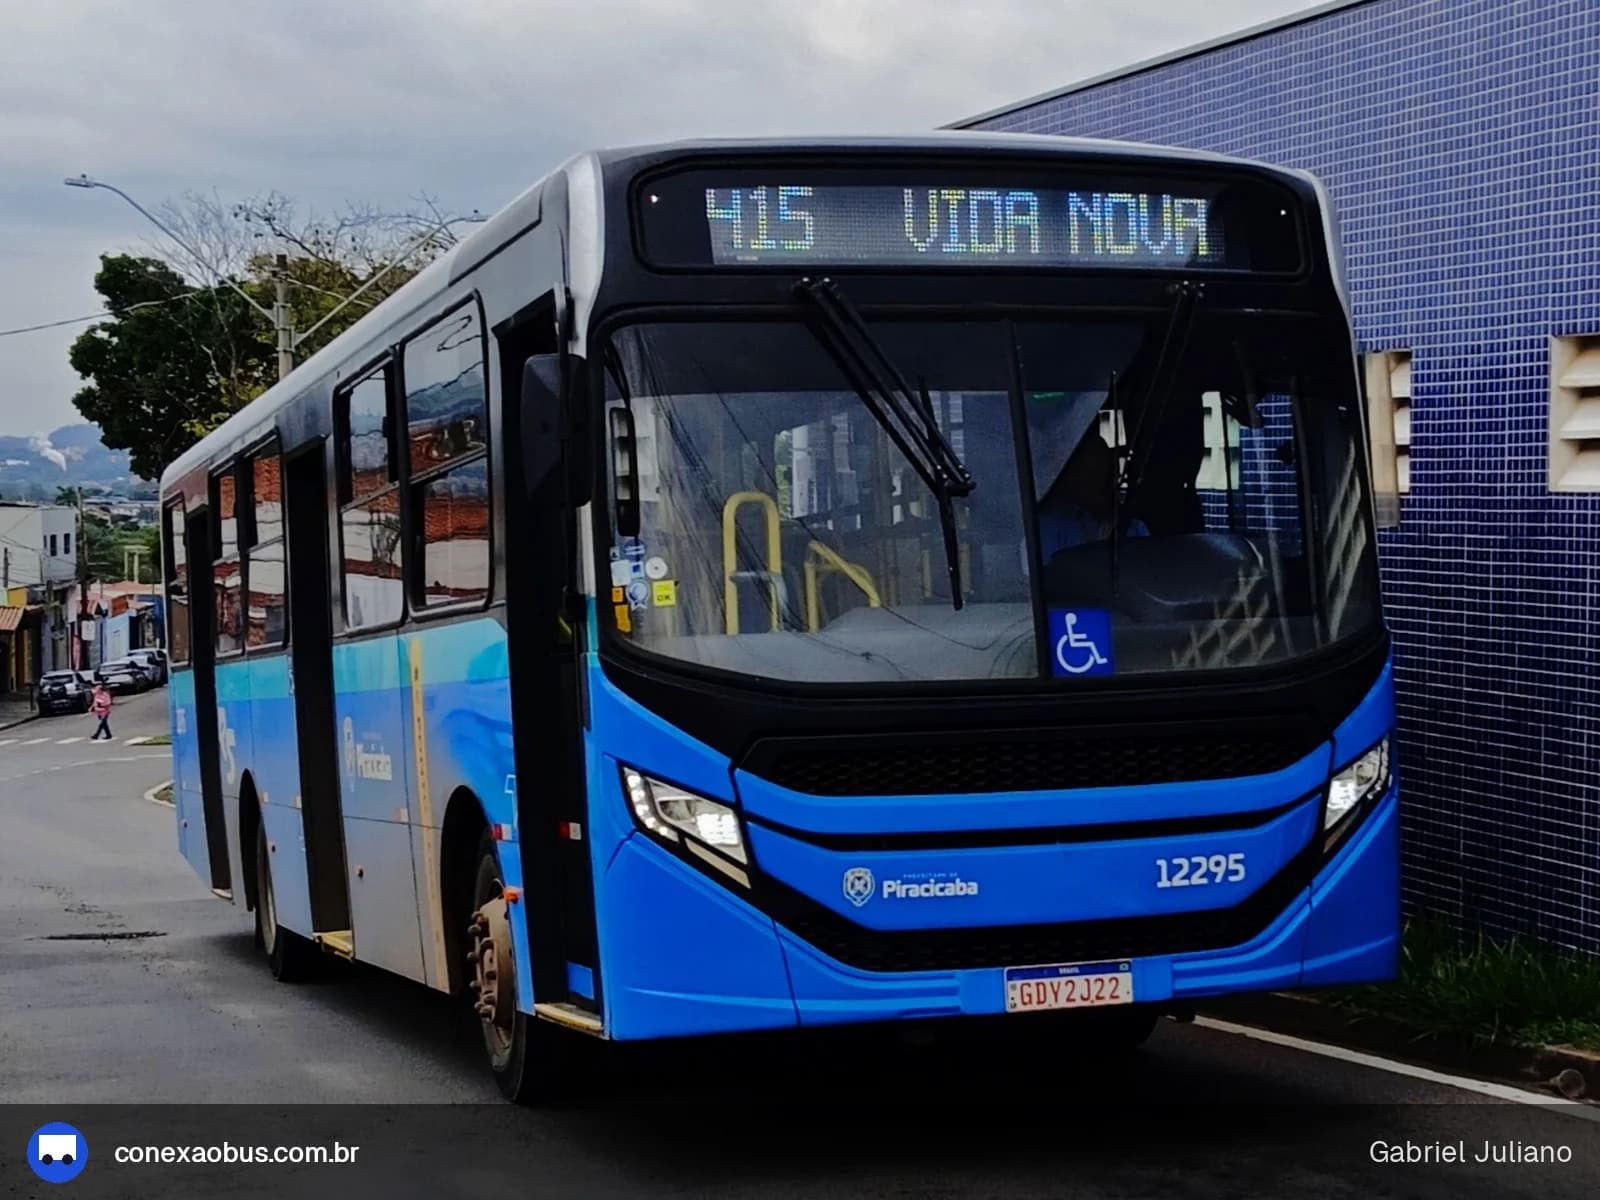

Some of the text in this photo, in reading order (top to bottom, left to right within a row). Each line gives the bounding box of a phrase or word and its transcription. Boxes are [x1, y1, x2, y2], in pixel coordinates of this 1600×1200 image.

[706, 186, 1208, 256] 415 VIDA NOVA
[1156, 853, 1246, 888] 12295
[882, 878, 979, 899] Piracicaba
[1020, 976, 1121, 1006] GDY2J22
